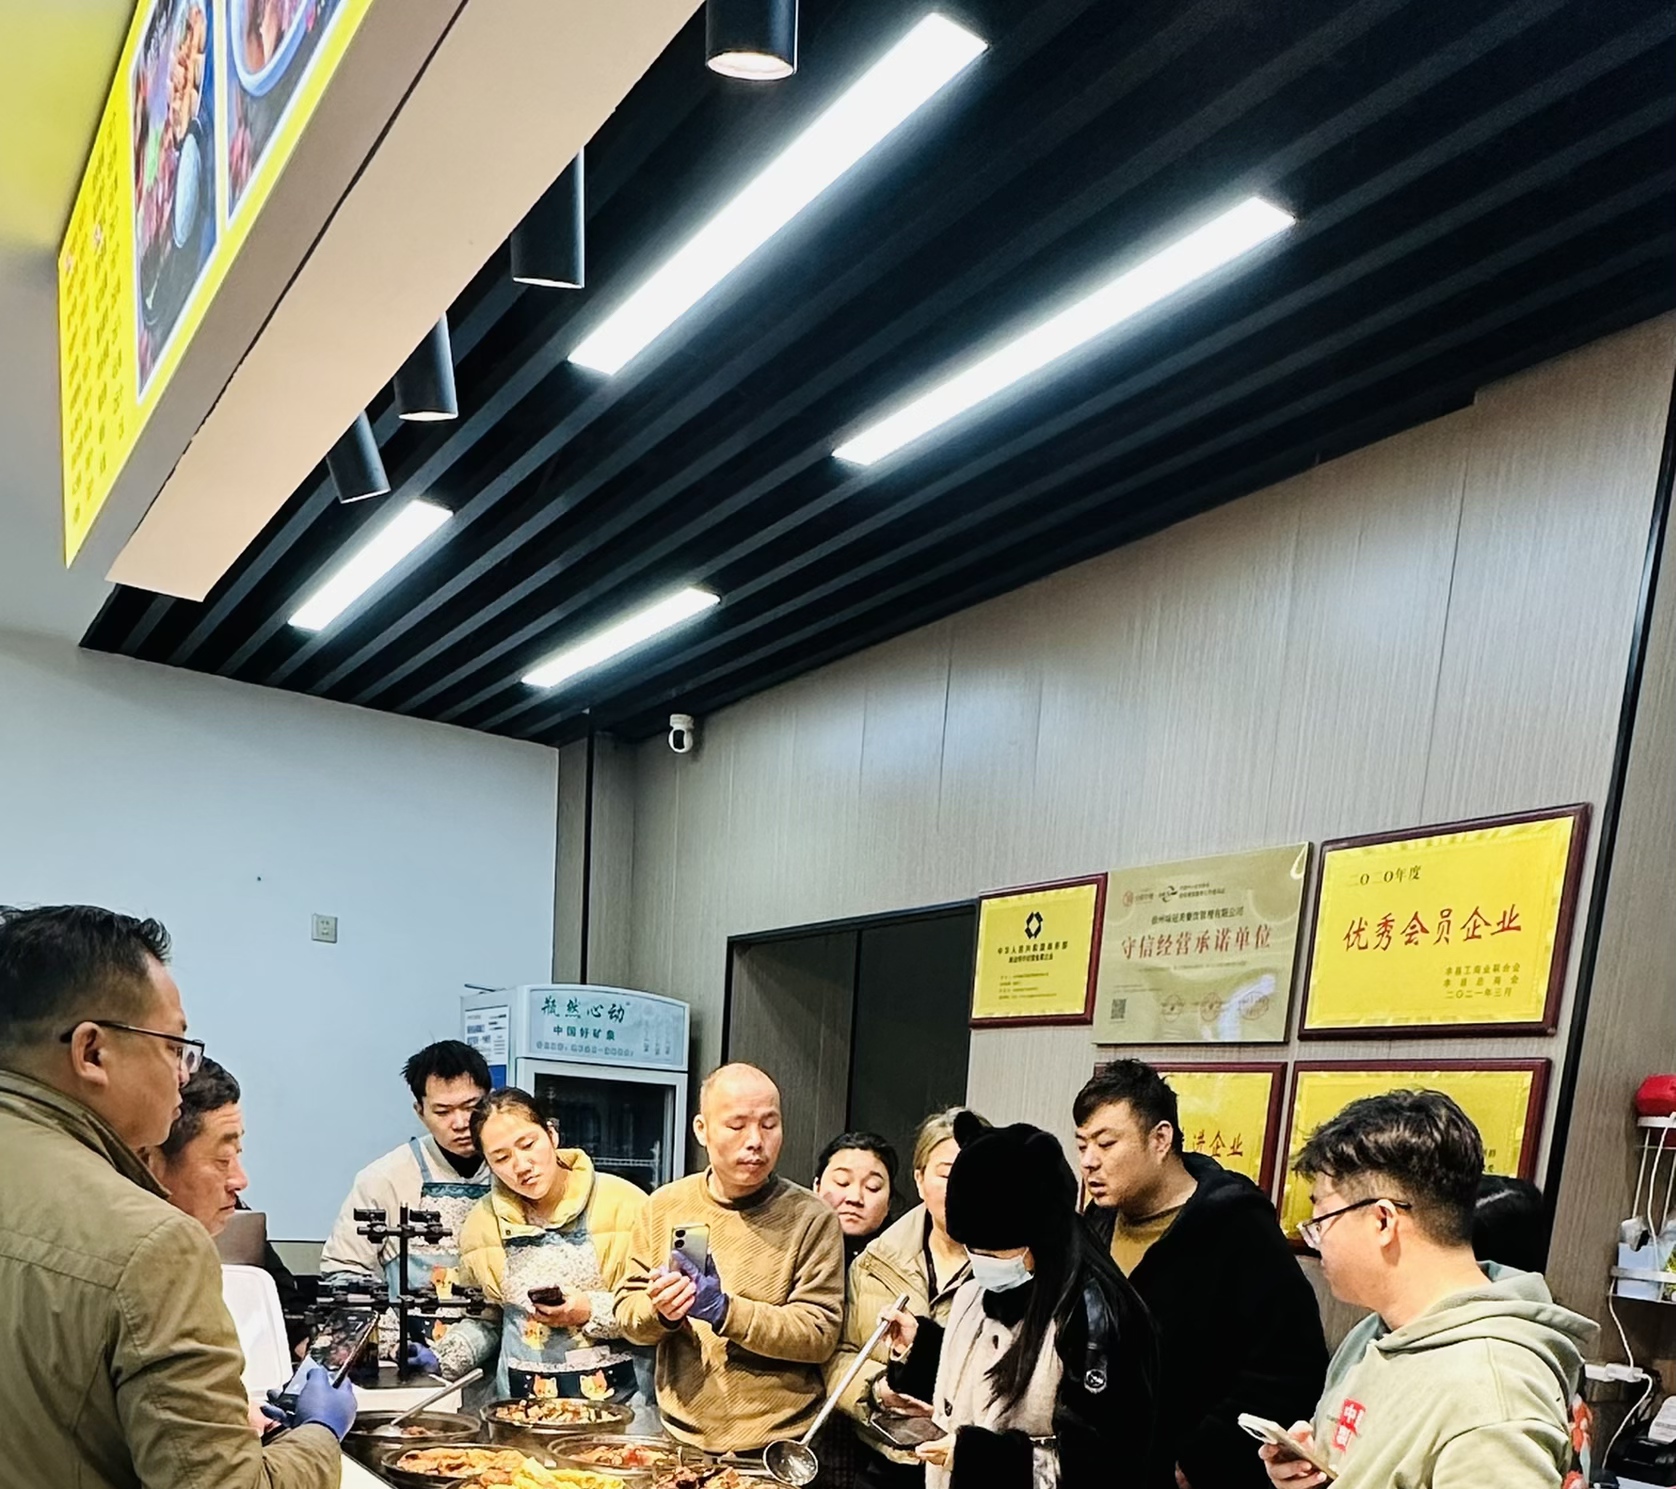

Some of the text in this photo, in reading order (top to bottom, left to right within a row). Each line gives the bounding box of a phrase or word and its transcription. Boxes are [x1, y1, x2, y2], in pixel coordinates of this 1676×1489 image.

[1122, 924, 1272, 959] 守信经营承诺单位
[1343, 904, 1522, 951] 优秀会员企业
